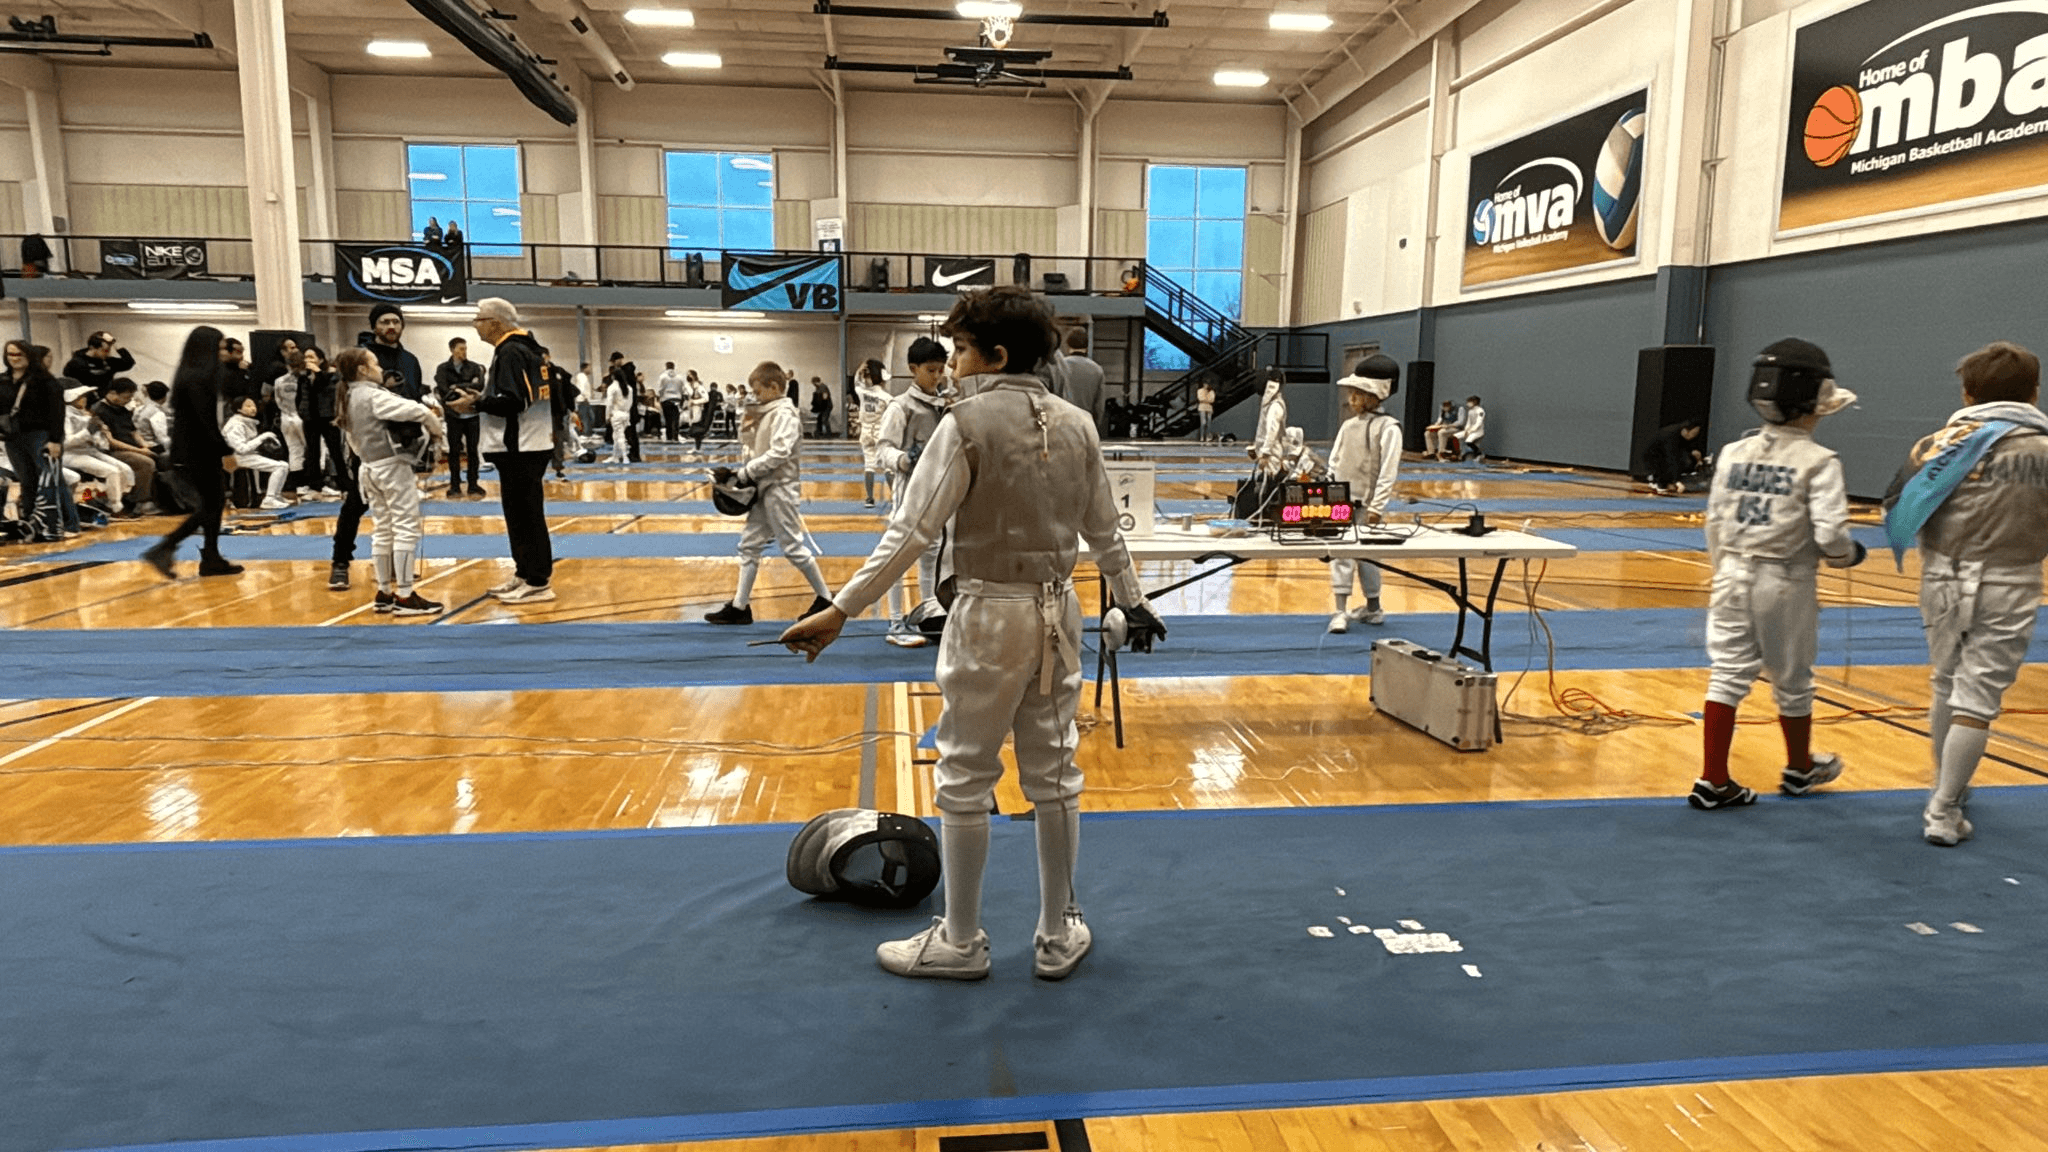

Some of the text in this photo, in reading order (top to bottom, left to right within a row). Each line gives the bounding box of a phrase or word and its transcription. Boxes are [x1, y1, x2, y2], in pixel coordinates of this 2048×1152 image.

[1858, 48, 1930, 89] Home of
[1849, 32, 2048, 155] mba
[1850, 149, 1906, 175] Michigan
[1908, 131, 1983, 162] Basketball
[1491, 183, 1574, 243] mva
[145, 245, 183, 257] NIKE
[361, 257, 442, 285] MSA
[785, 283, 838, 310] VB
[1121, 494, 1130, 509] 1
